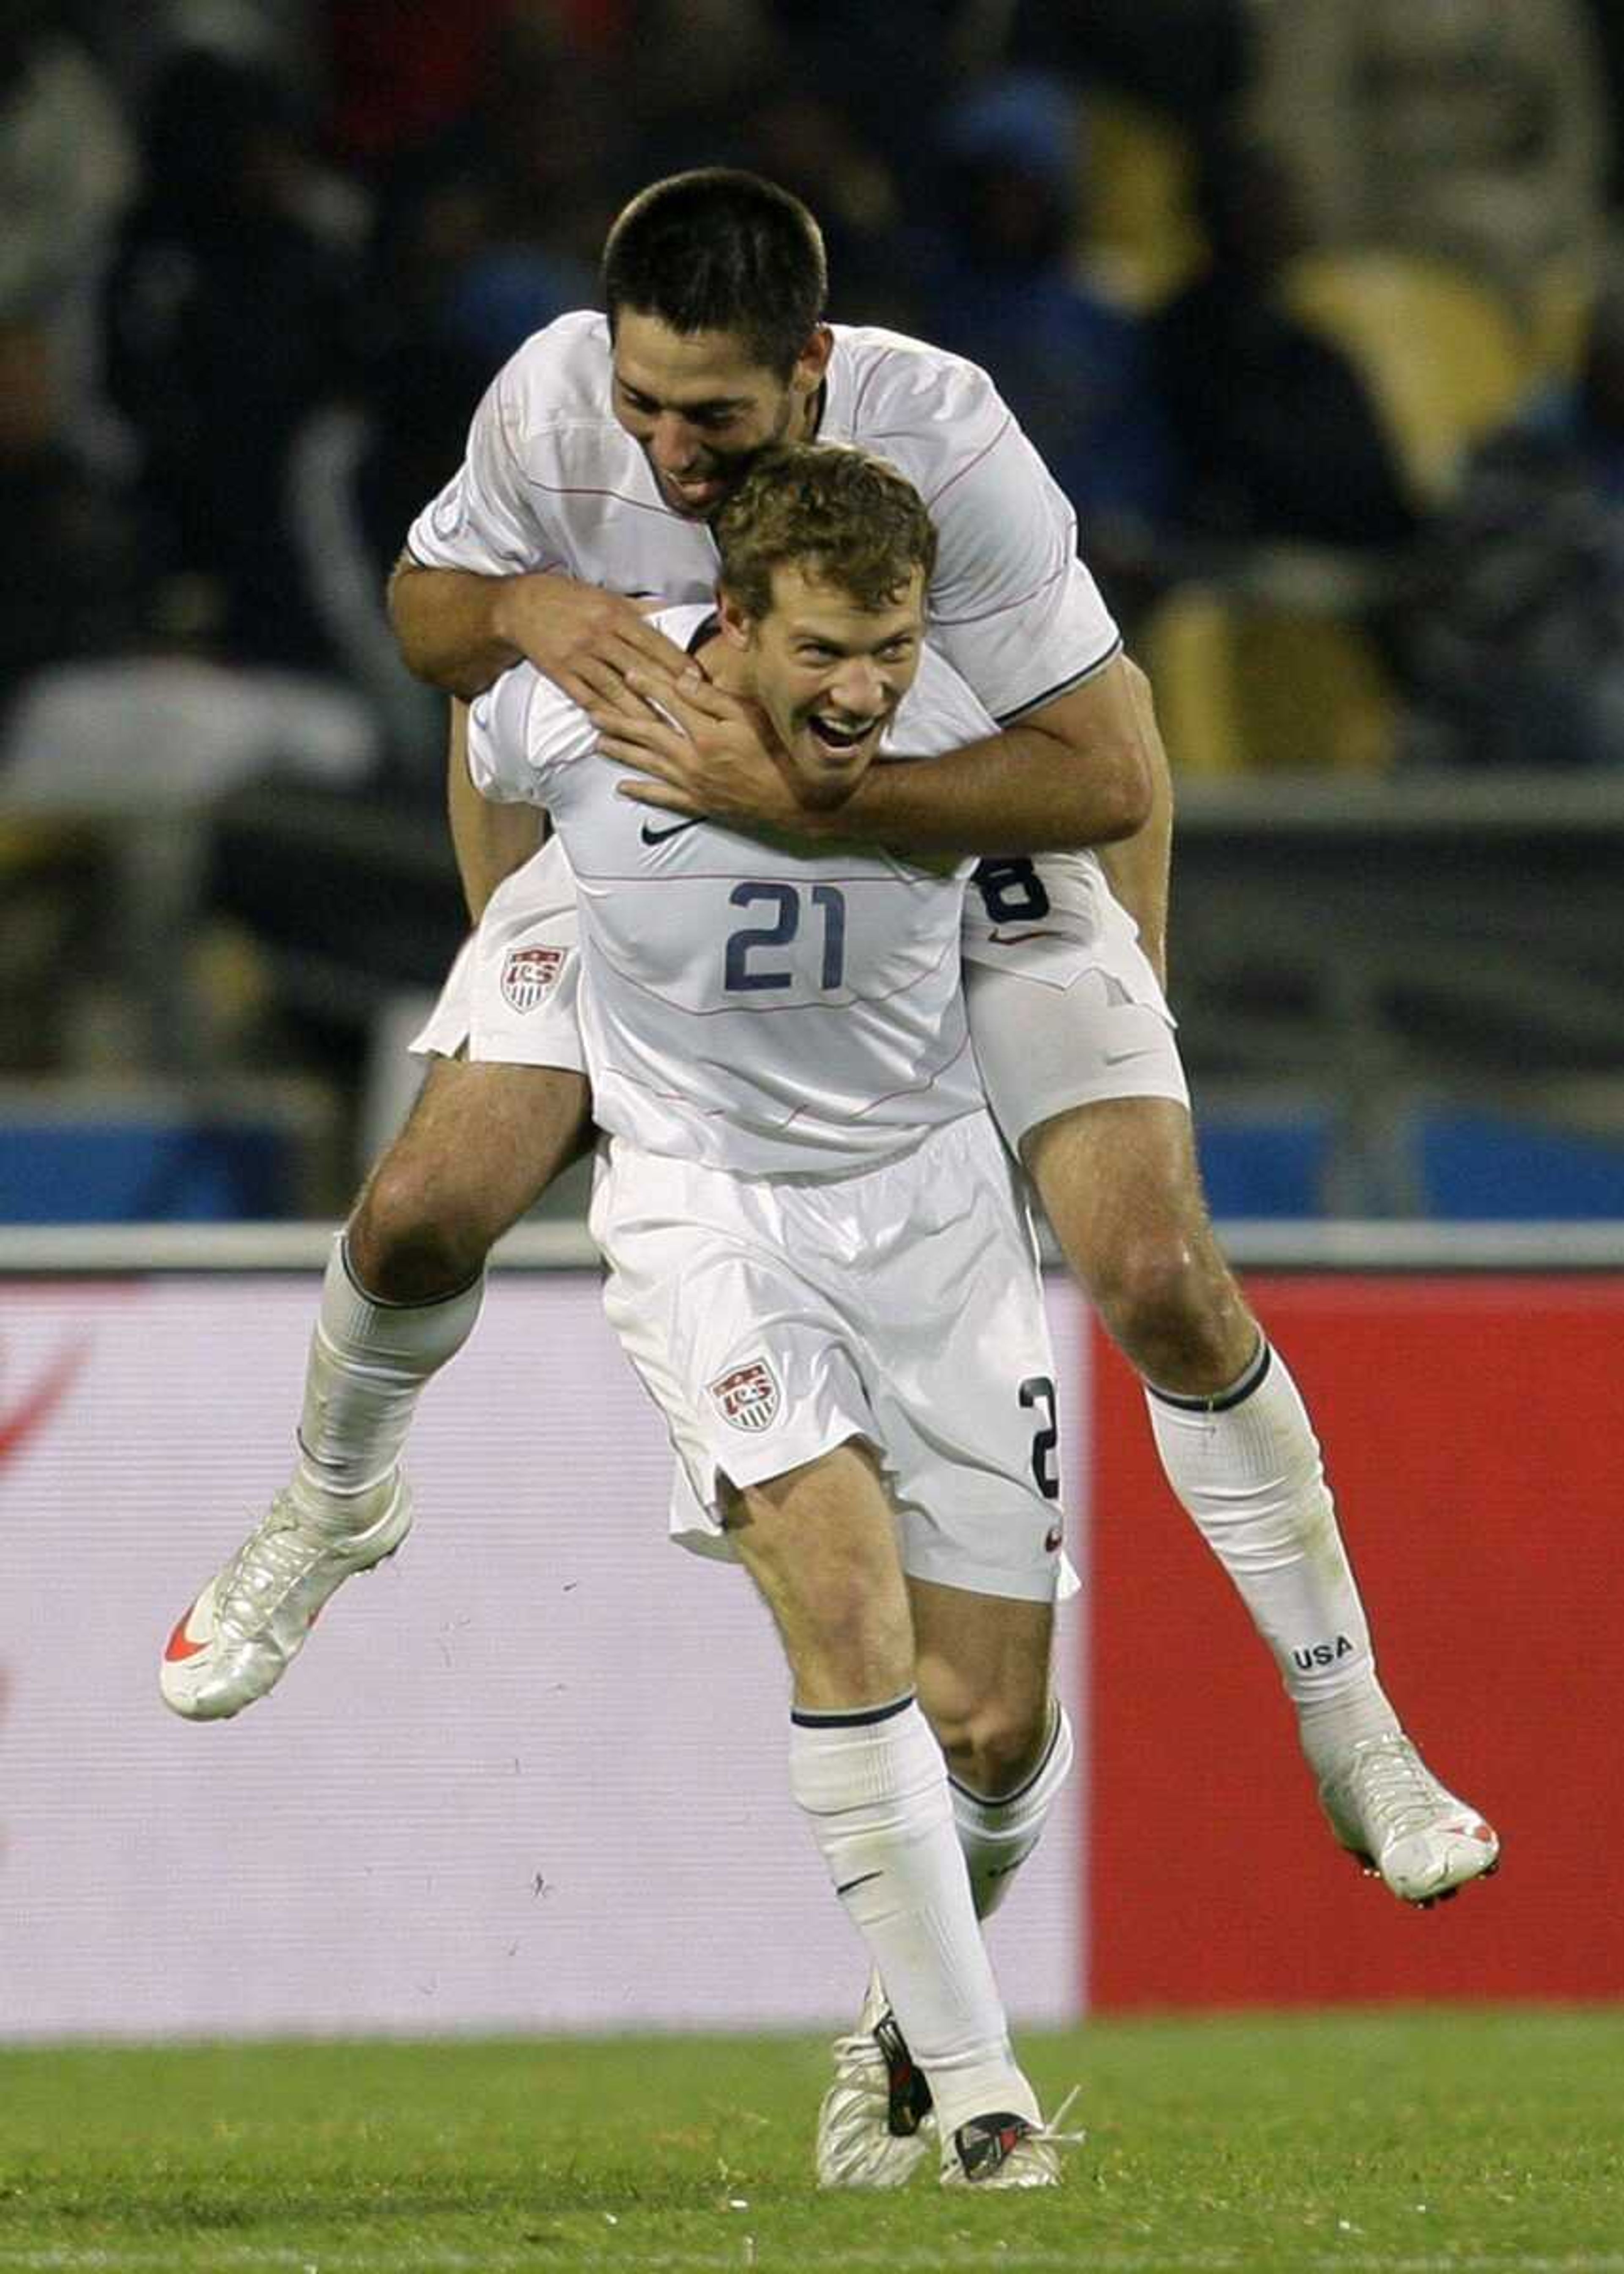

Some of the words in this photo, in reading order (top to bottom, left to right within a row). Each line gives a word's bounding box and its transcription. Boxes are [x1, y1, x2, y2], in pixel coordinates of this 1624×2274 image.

[971, 856, 1050, 924] 8
[725, 881, 845, 990] 21
[1294, 1635, 1353, 1669] USA
